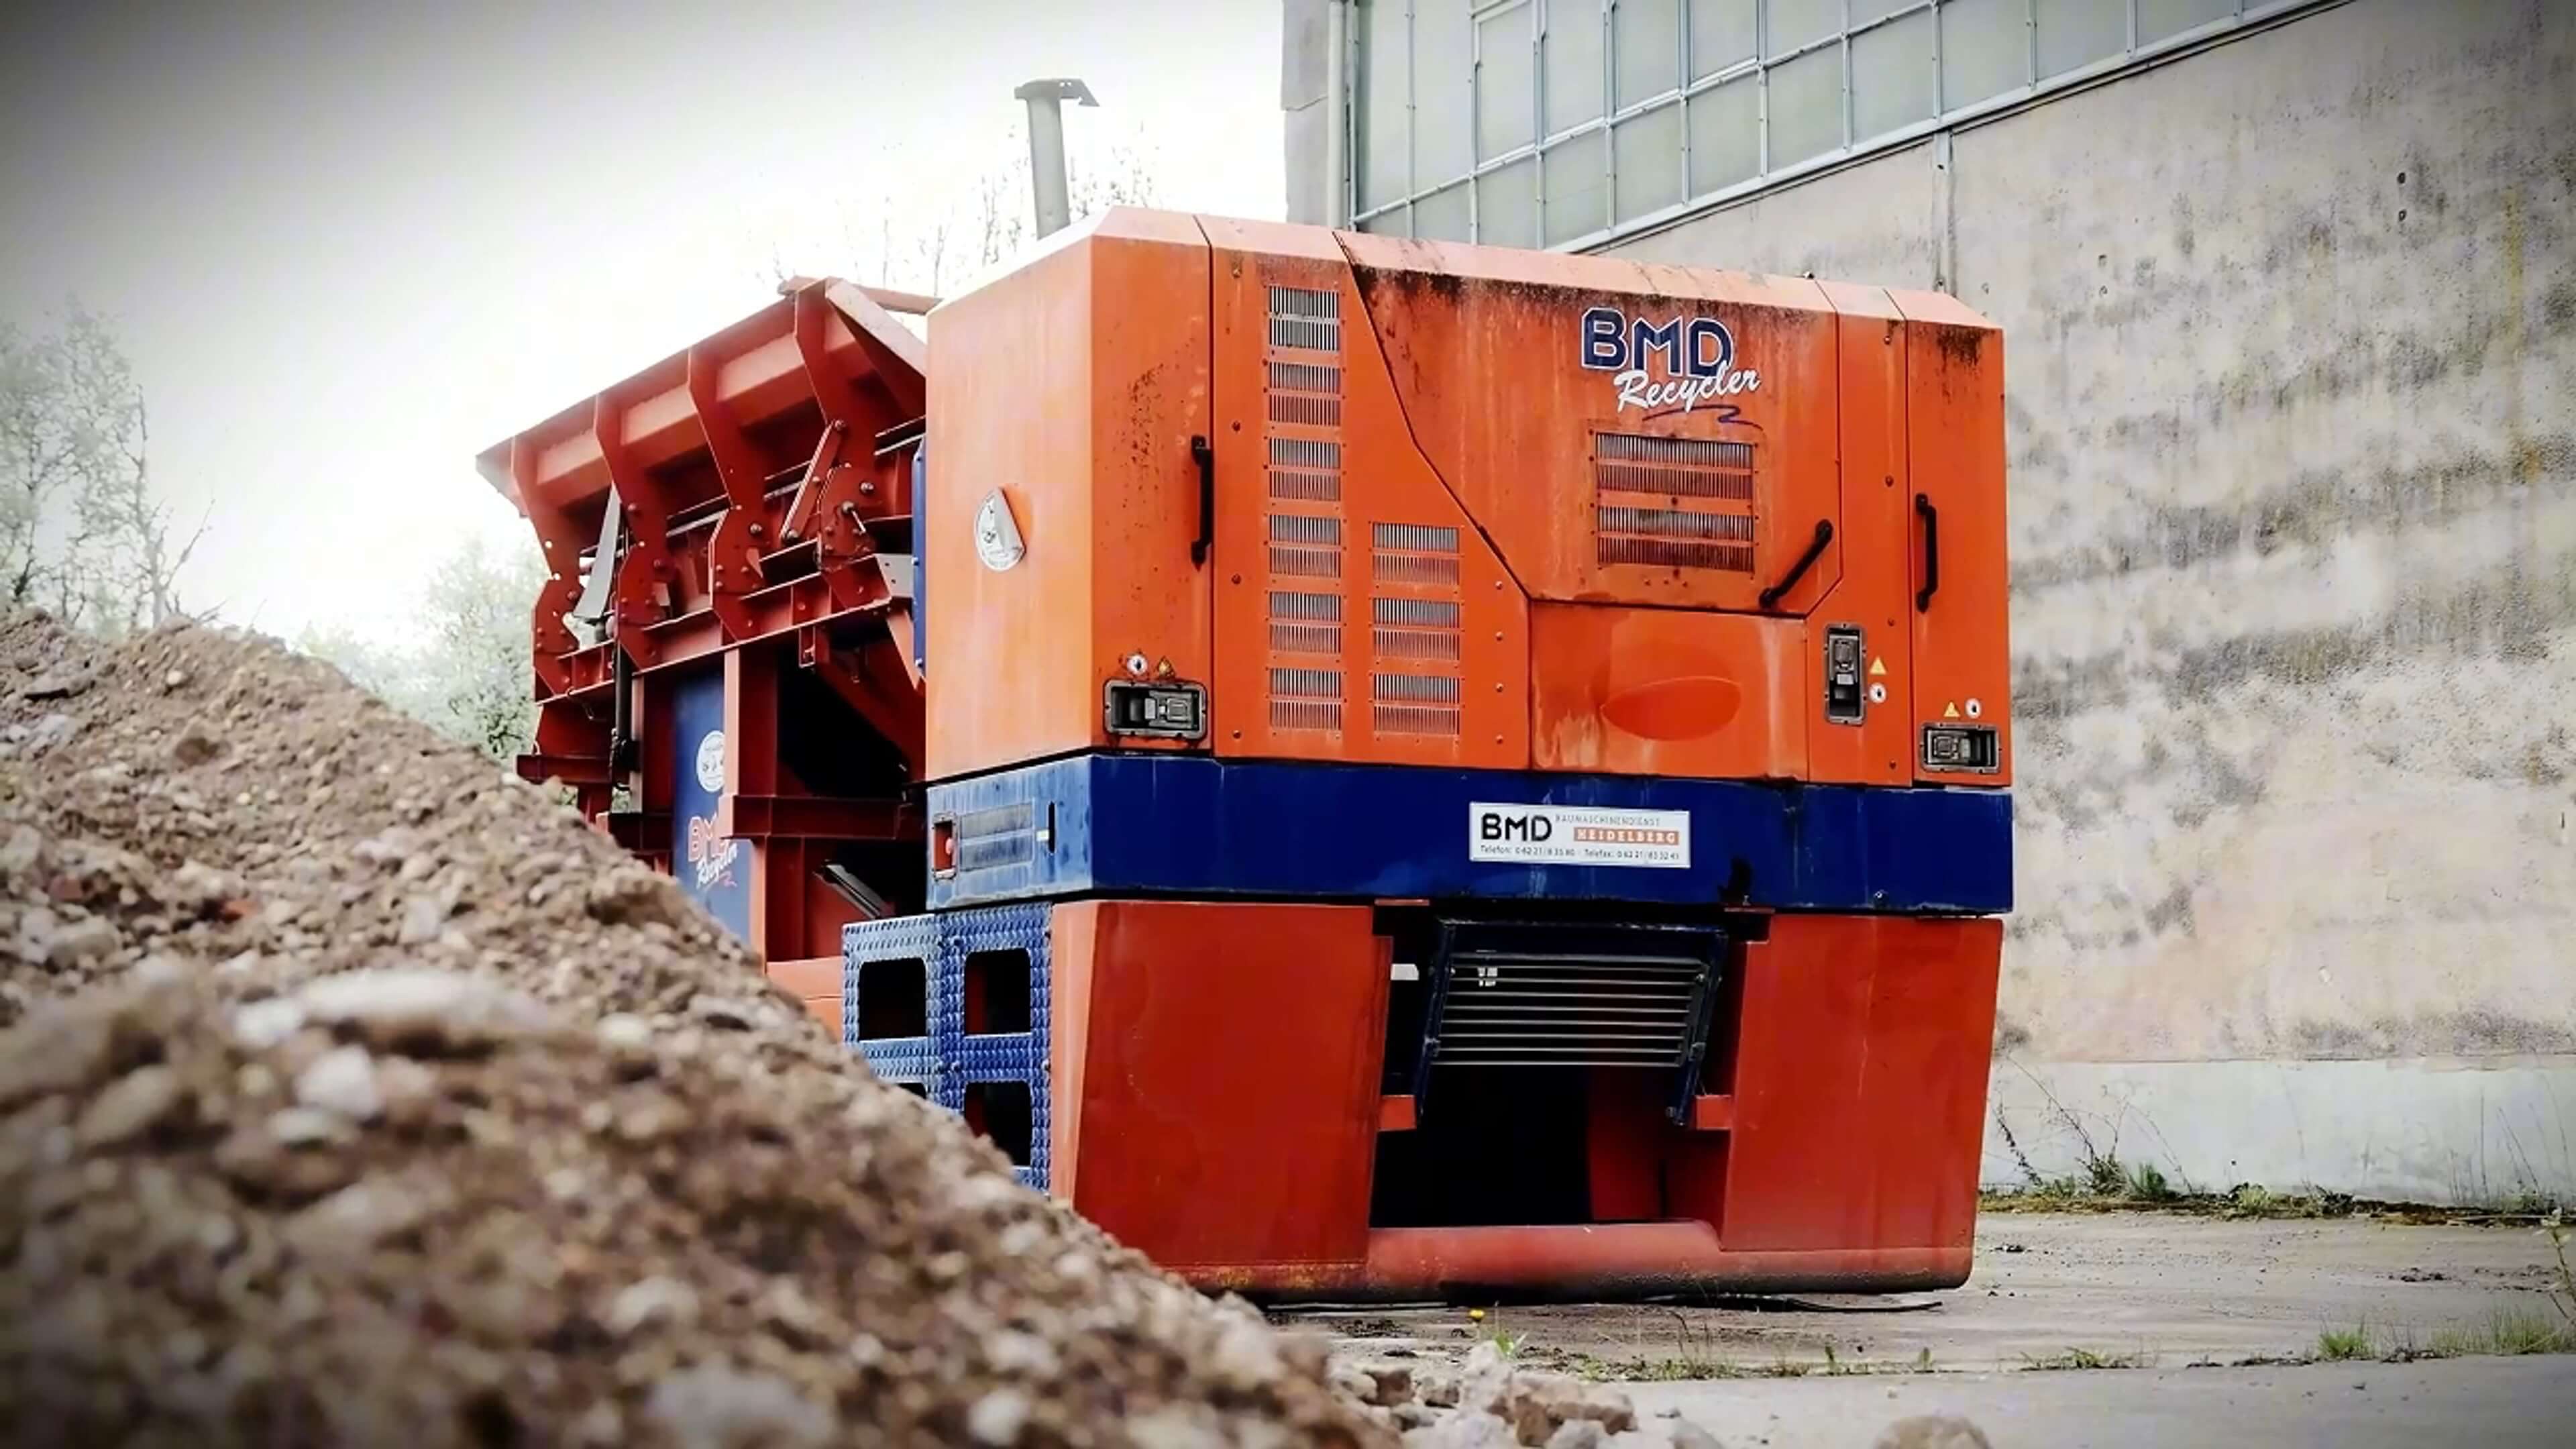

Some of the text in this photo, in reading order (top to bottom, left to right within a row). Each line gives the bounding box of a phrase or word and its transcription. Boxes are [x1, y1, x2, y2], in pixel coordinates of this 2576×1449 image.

[1582, 307, 1734, 378] BMD
[1613, 360, 1761, 413] Recycler
[1481, 812, 1552, 842] BMD
[1576, 828, 1677, 844] HEIDELBERG
